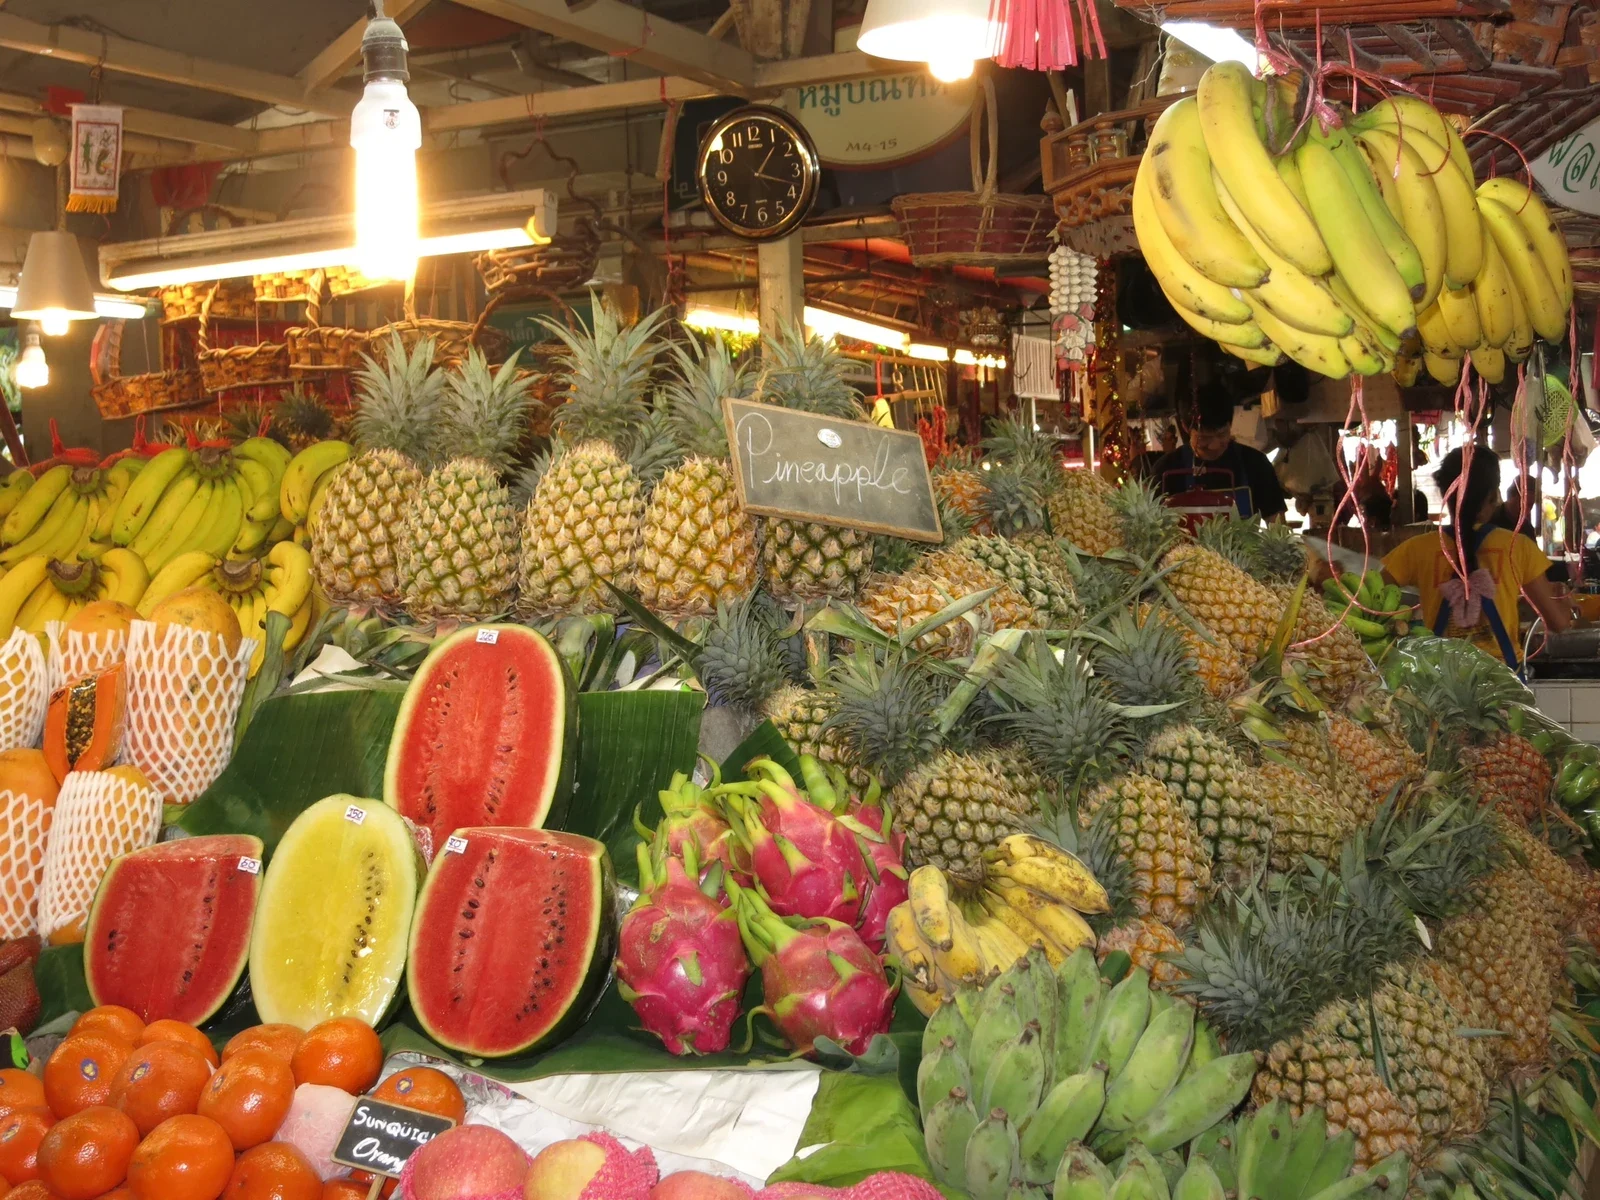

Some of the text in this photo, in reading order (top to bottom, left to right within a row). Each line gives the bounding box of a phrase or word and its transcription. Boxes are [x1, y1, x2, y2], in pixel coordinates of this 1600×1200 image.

[732, 132, 742, 148] 11
[748, 126, 760, 141] 12
[770, 128, 775, 143] 1
[783, 141, 793, 157] 2
[845, 138, 898, 152] M4-15
[720, 148, 734, 164] 10
[717, 170, 728, 186] 9
[791, 163, 801, 178] 3
[726, 191, 736, 206] 8
[787, 184, 797, 199] 4
[740, 204, 748, 219] 7
[757, 207, 768, 222] 6
[775, 200, 785, 216] 5
[735, 412, 912, 506] Pineapple
[241, 859, 256, 869] 60
[352, 1137, 408, 1173] Orang
